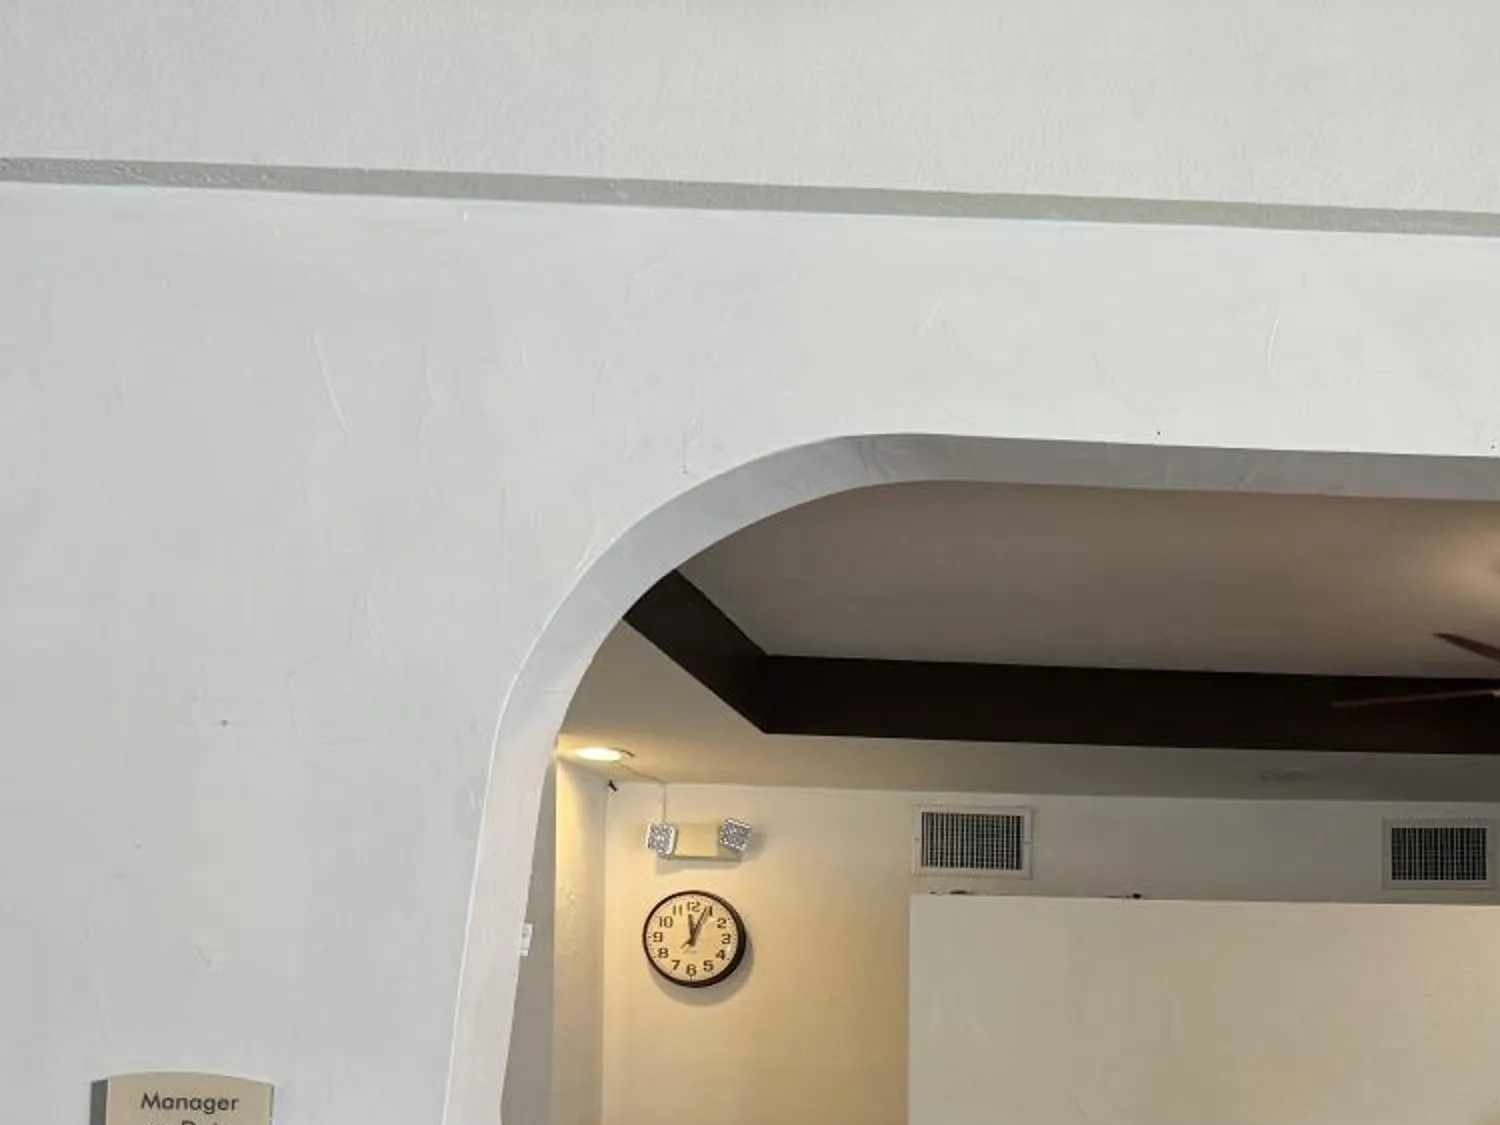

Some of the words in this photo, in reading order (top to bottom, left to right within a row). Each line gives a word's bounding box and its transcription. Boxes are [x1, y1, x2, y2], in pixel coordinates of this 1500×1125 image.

[672, 904, 683, 916] 11
[687, 901, 700, 912] 12
[659, 916, 673, 928] 10
[717, 917, 727, 929] 2
[653, 932, 663, 943] 9
[721, 934, 731, 945] 3
[658, 947, 669, 959] 8
[716, 949, 726, 960] 4
[672, 960, 680, 971] 7
[686, 964, 697, 976] 6
[703, 960, 714, 972] 5
[141, 1090, 240, 1115] Manager
